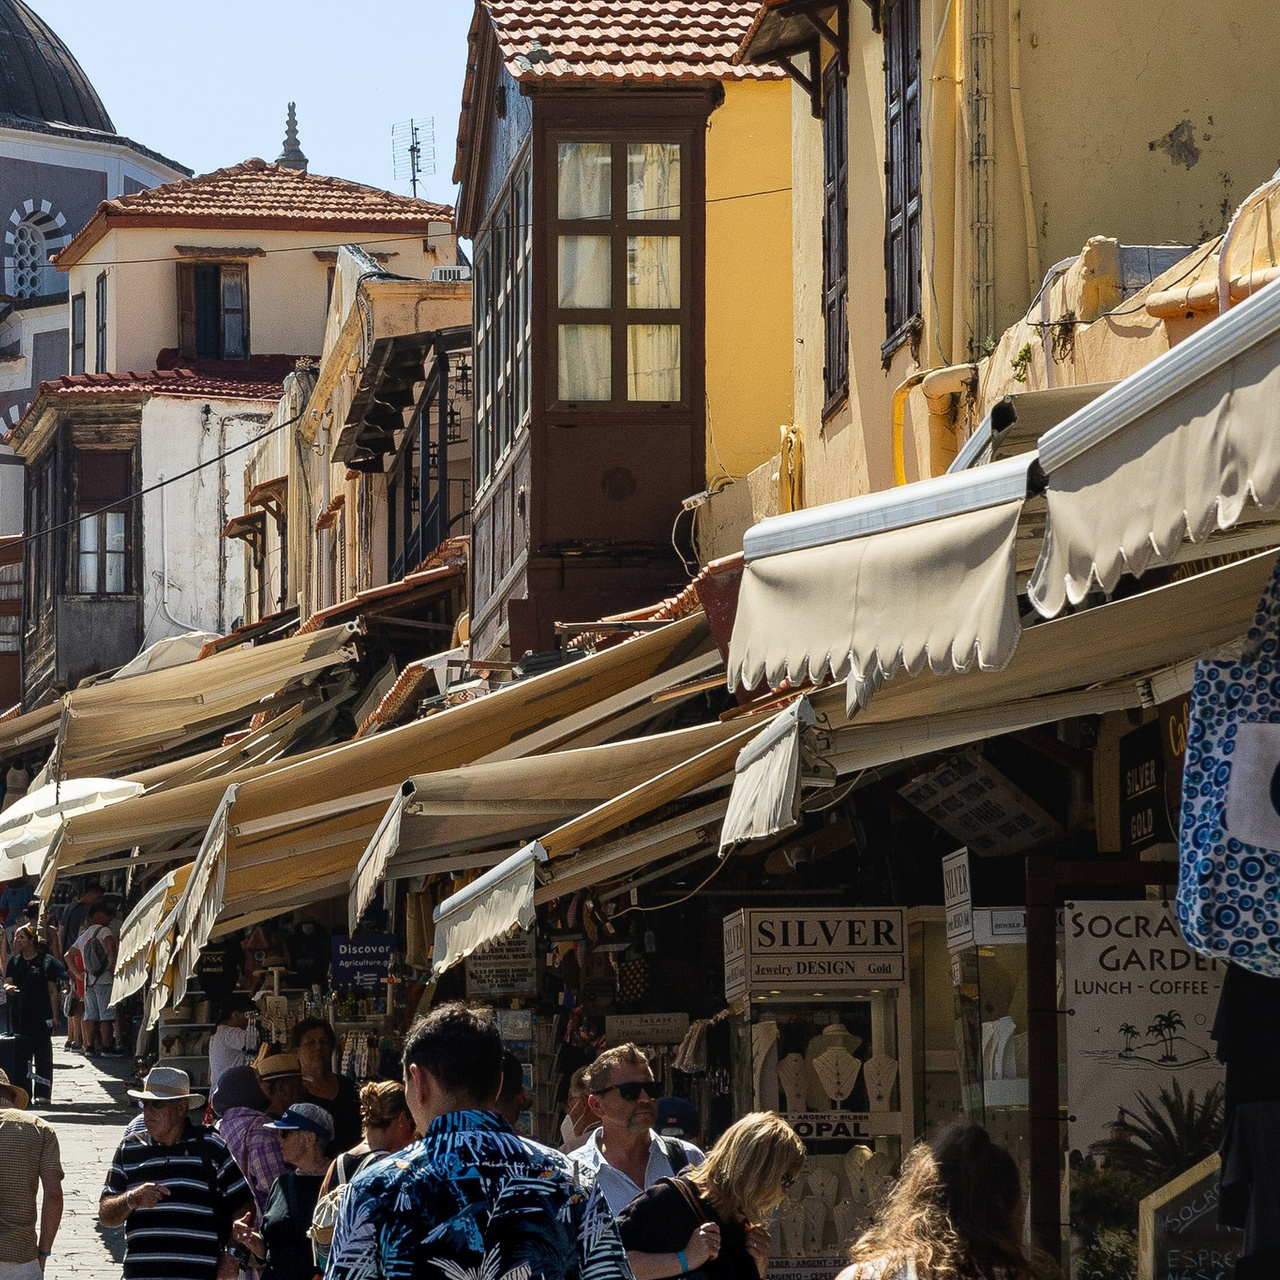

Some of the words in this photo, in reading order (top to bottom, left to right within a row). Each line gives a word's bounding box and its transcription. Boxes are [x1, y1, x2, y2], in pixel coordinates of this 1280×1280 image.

[1168, 701, 1188, 756] Caf
[1126, 758, 1156, 795] SILVER
[1131, 807, 1153, 839] GOLD
[1071, 912, 1180, 938] SOCRA
[757, 919, 897, 948] SILVER
[338, 944, 390, 954] Discover
[470, 953, 510, 961] TRADITIONAL
[754, 964, 793, 976] Jewelry
[796, 960, 856, 975] DESIGN
[867, 962, 892, 975] Gold
[1074, 978, 1131, 995] LUNCH
[1149, 978, 1208, 995] COFFEE
[793, 1122, 869, 1137] OPAL
[796, 1259, 827, 1268] ARGENT
[766, 1273, 803, 1280] ARGENTO
